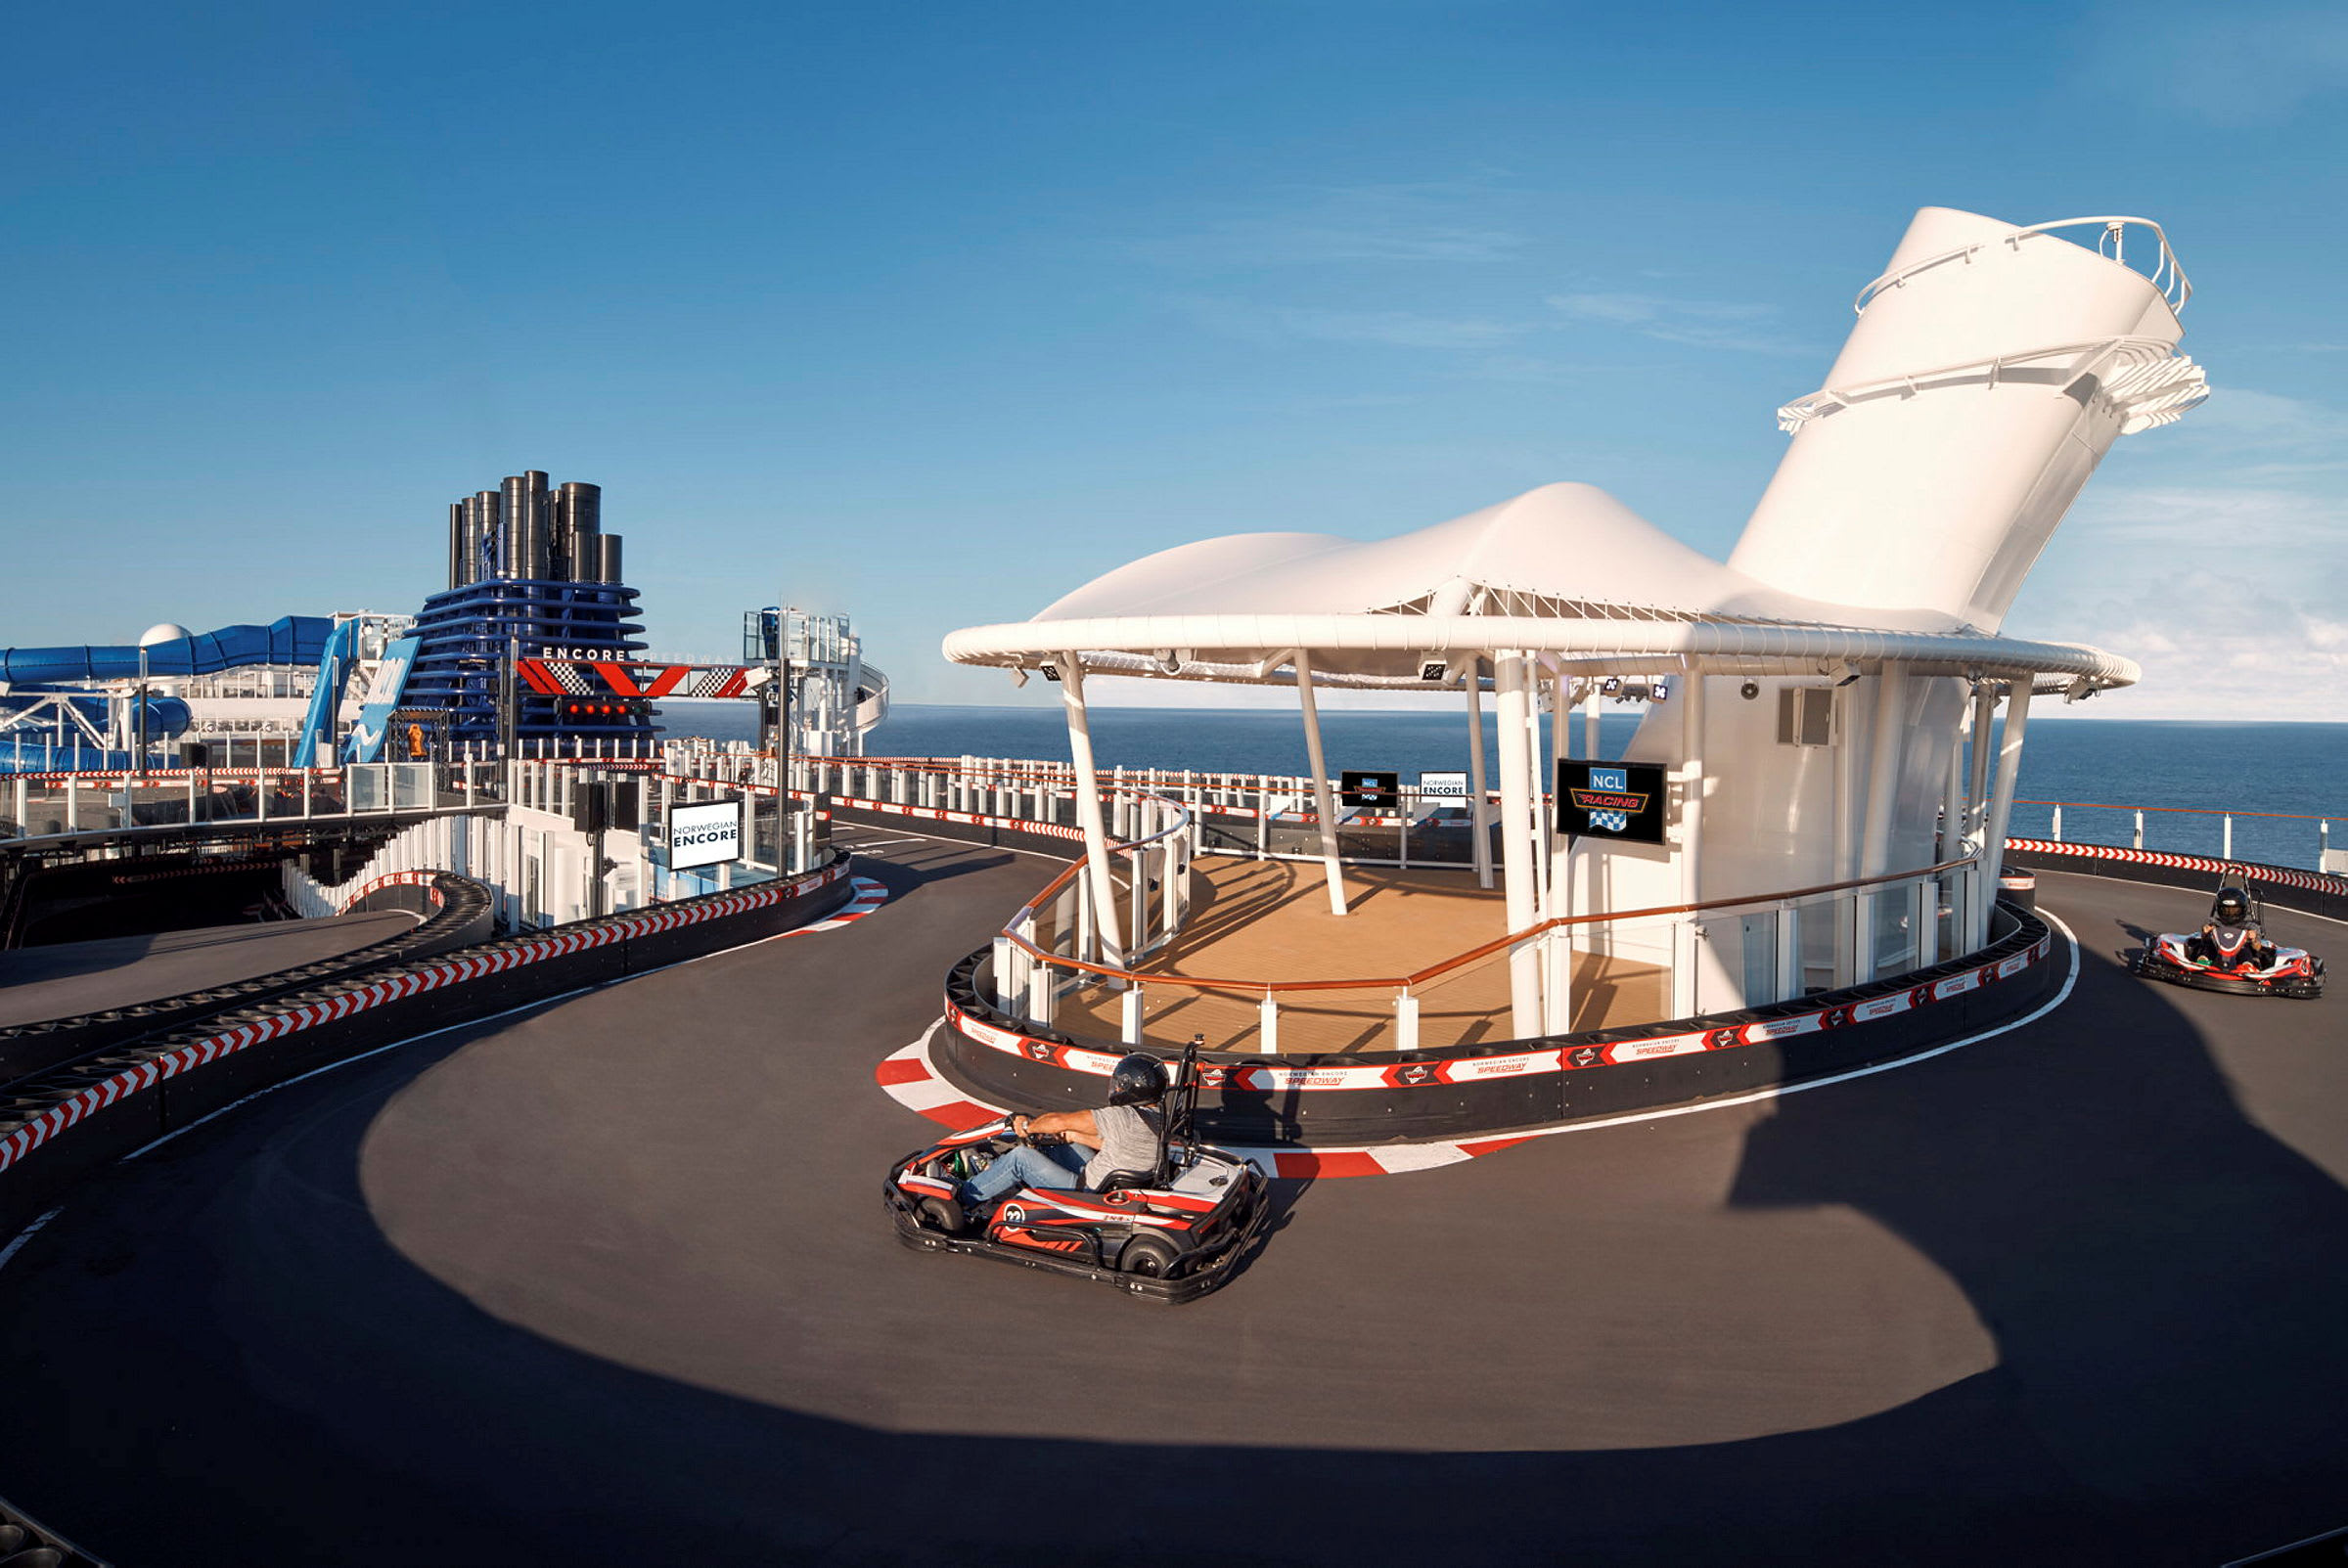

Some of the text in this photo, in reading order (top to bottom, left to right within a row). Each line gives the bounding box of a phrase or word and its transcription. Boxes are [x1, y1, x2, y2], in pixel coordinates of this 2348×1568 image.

[542, 647, 735, 665] ENCORE SPEEDWAY
[1593, 775, 1624, 789] NCL
[1423, 786, 1464, 795] ENCORE
[1579, 793, 1640, 808] RACING
[673, 821, 738, 835] NORWEGIAN
[673, 829, 738, 848] ENCORE
[1091, 1060, 1116, 1072] SPEE
[1477, 1062, 1527, 1074] SPEEDWAY
[1284, 1077, 1345, 1086] SPEEDWAY
